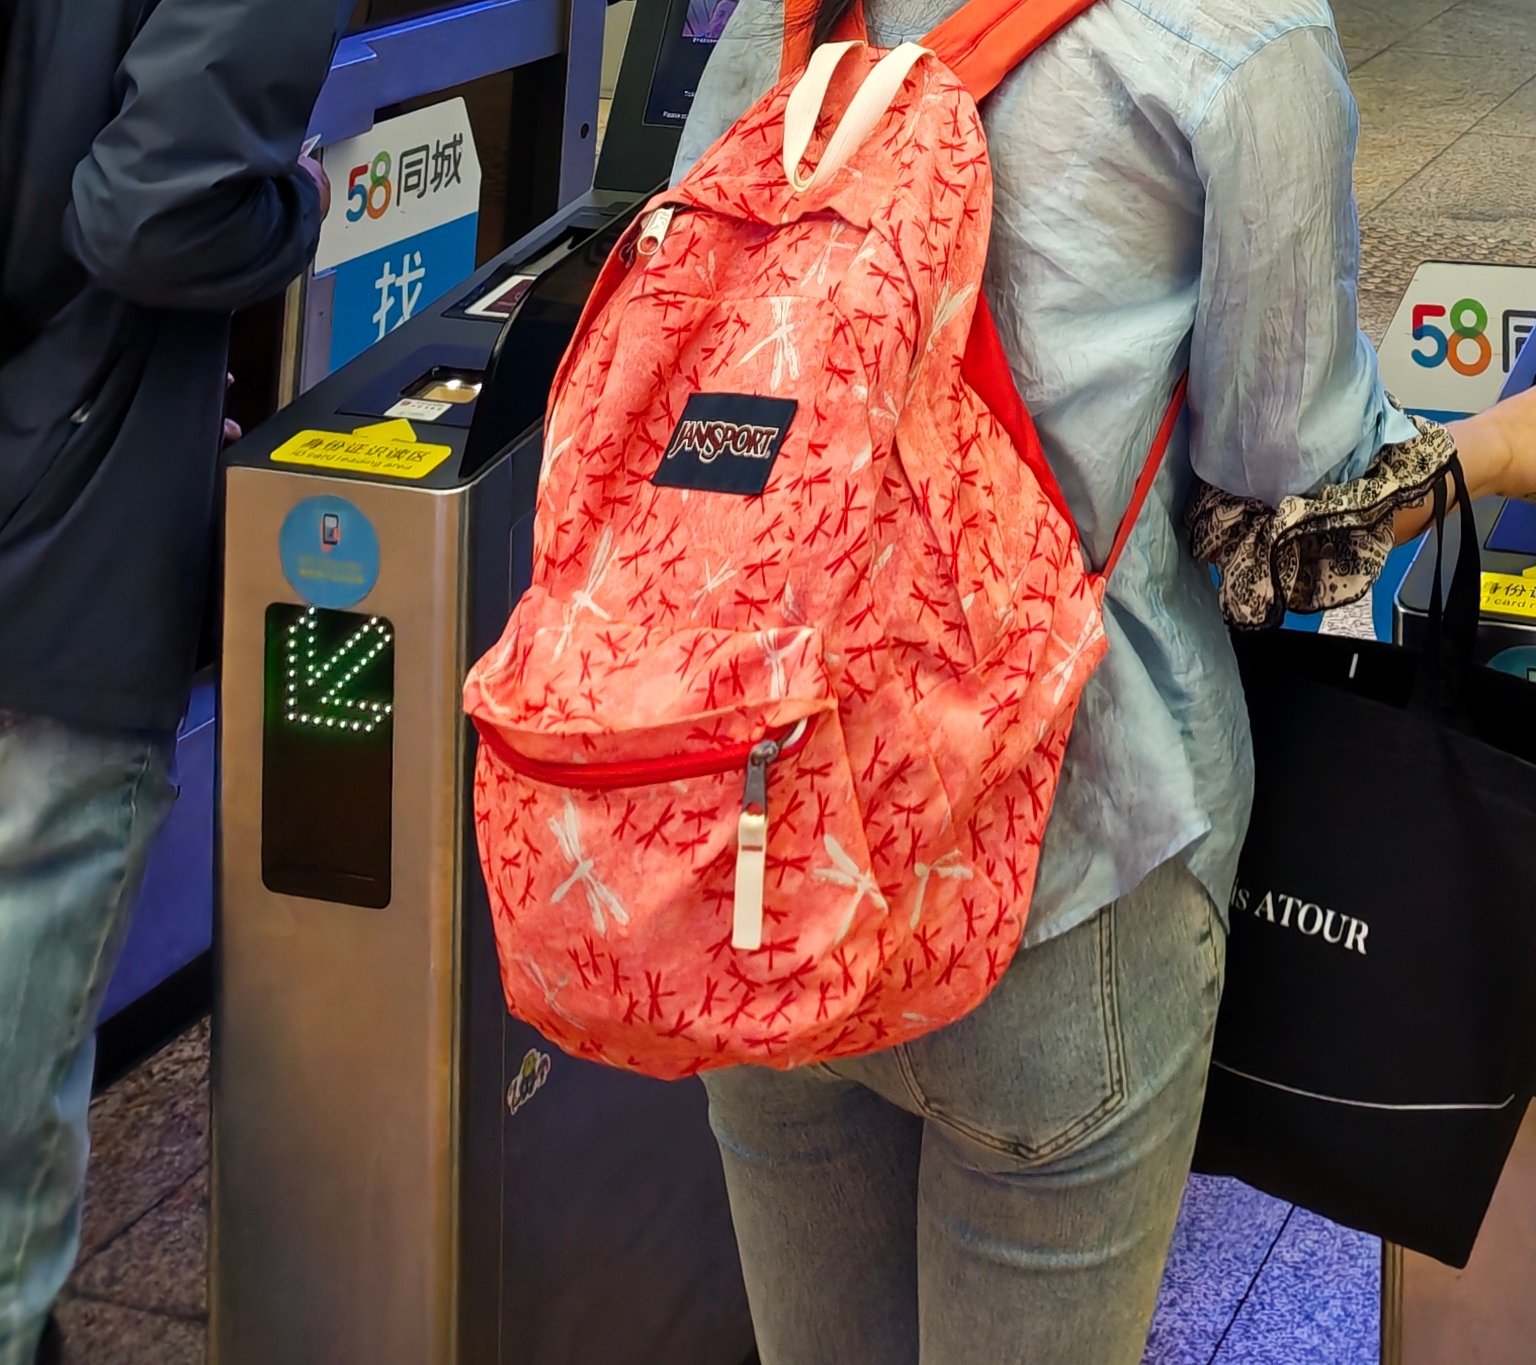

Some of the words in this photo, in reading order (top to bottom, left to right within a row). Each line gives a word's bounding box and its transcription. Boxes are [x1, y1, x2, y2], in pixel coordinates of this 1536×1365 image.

[345, 132, 464, 222] 58同城
[372, 250, 426, 343] 找
[667, 420, 779, 463] JANSPORT
[1494, 598, 1526, 609] card
[1254, 889, 1370, 955] ATOUR
